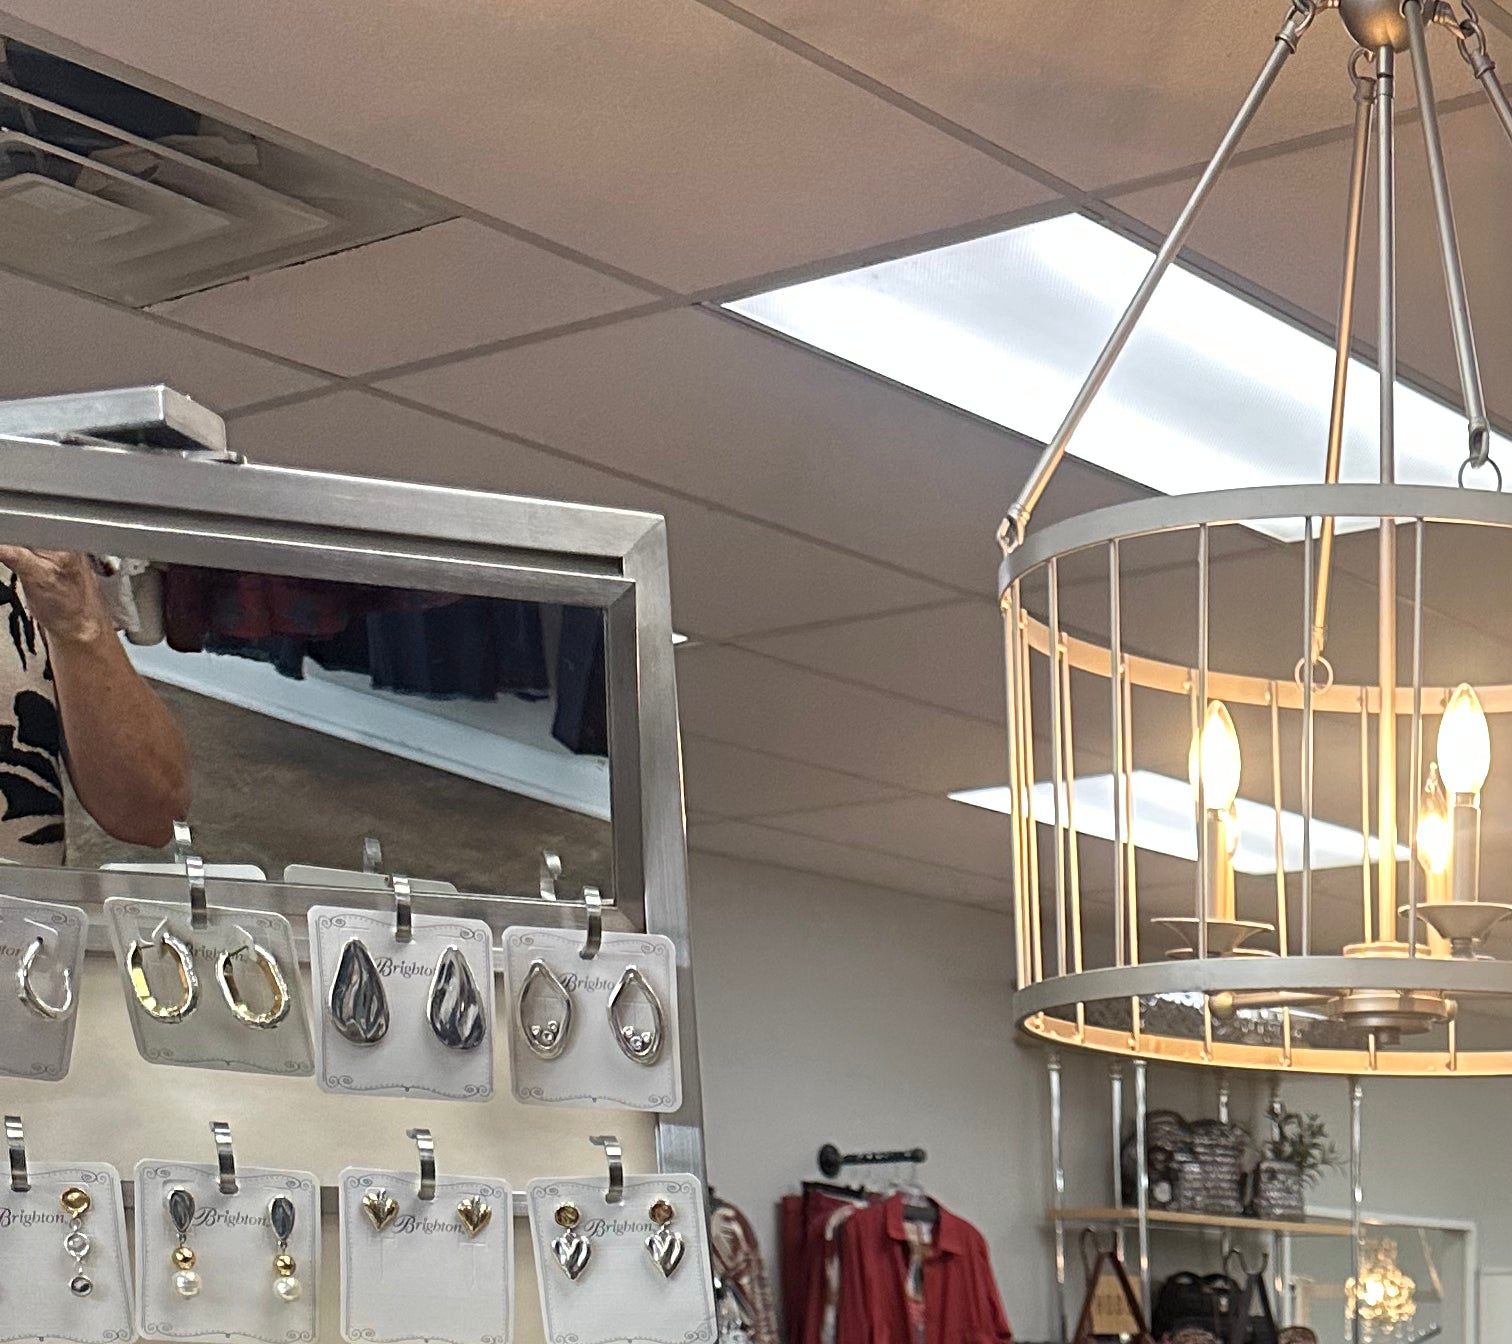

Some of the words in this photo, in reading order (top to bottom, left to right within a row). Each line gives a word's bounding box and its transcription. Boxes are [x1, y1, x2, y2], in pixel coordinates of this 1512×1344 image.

[376, 956, 436, 977] Brighto
[560, 973, 615, 993] Brighto
[192, 1207, 267, 1227] Brighton
[393, 1215, 461, 1235] Brighton
[583, 1217, 653, 1238] Brighton
